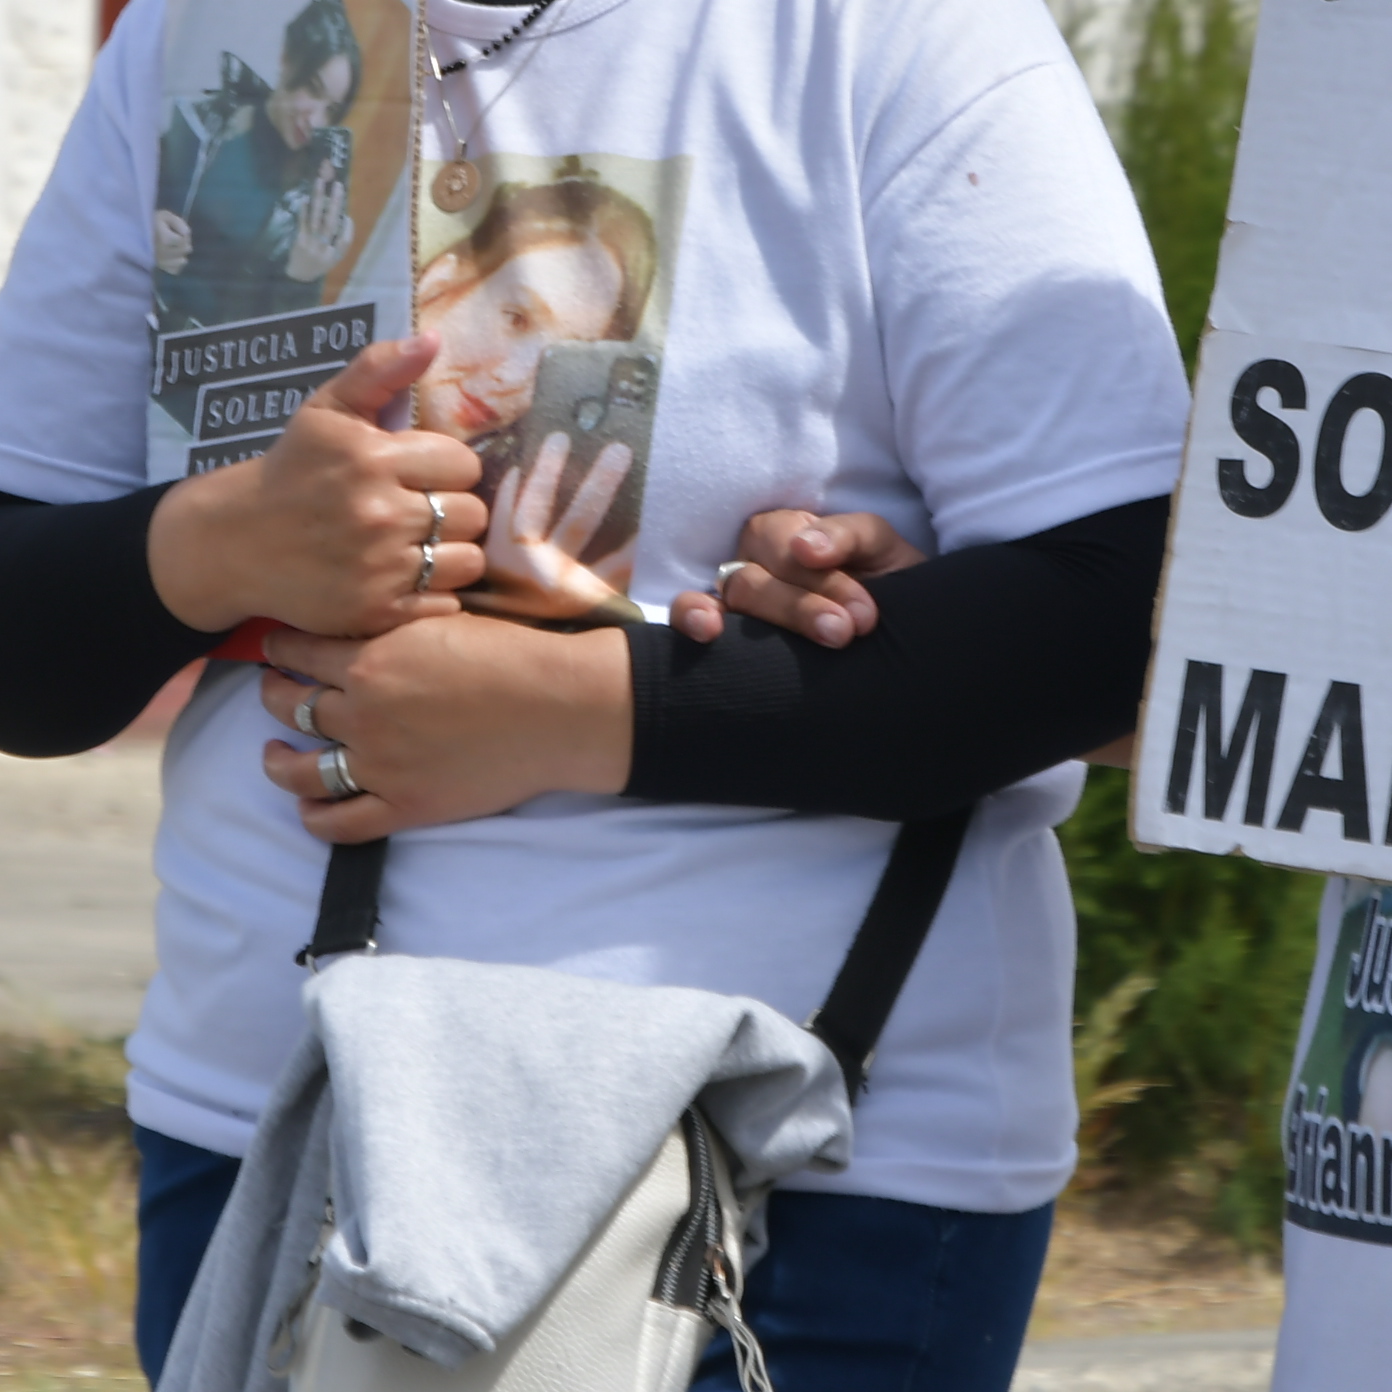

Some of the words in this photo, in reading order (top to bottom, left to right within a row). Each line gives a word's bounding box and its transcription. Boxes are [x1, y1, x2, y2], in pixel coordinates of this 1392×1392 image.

[165, 330, 298, 385] JUSTICIA
[311, 318, 368, 355] POR
[207, 384, 318, 430] SOLED
